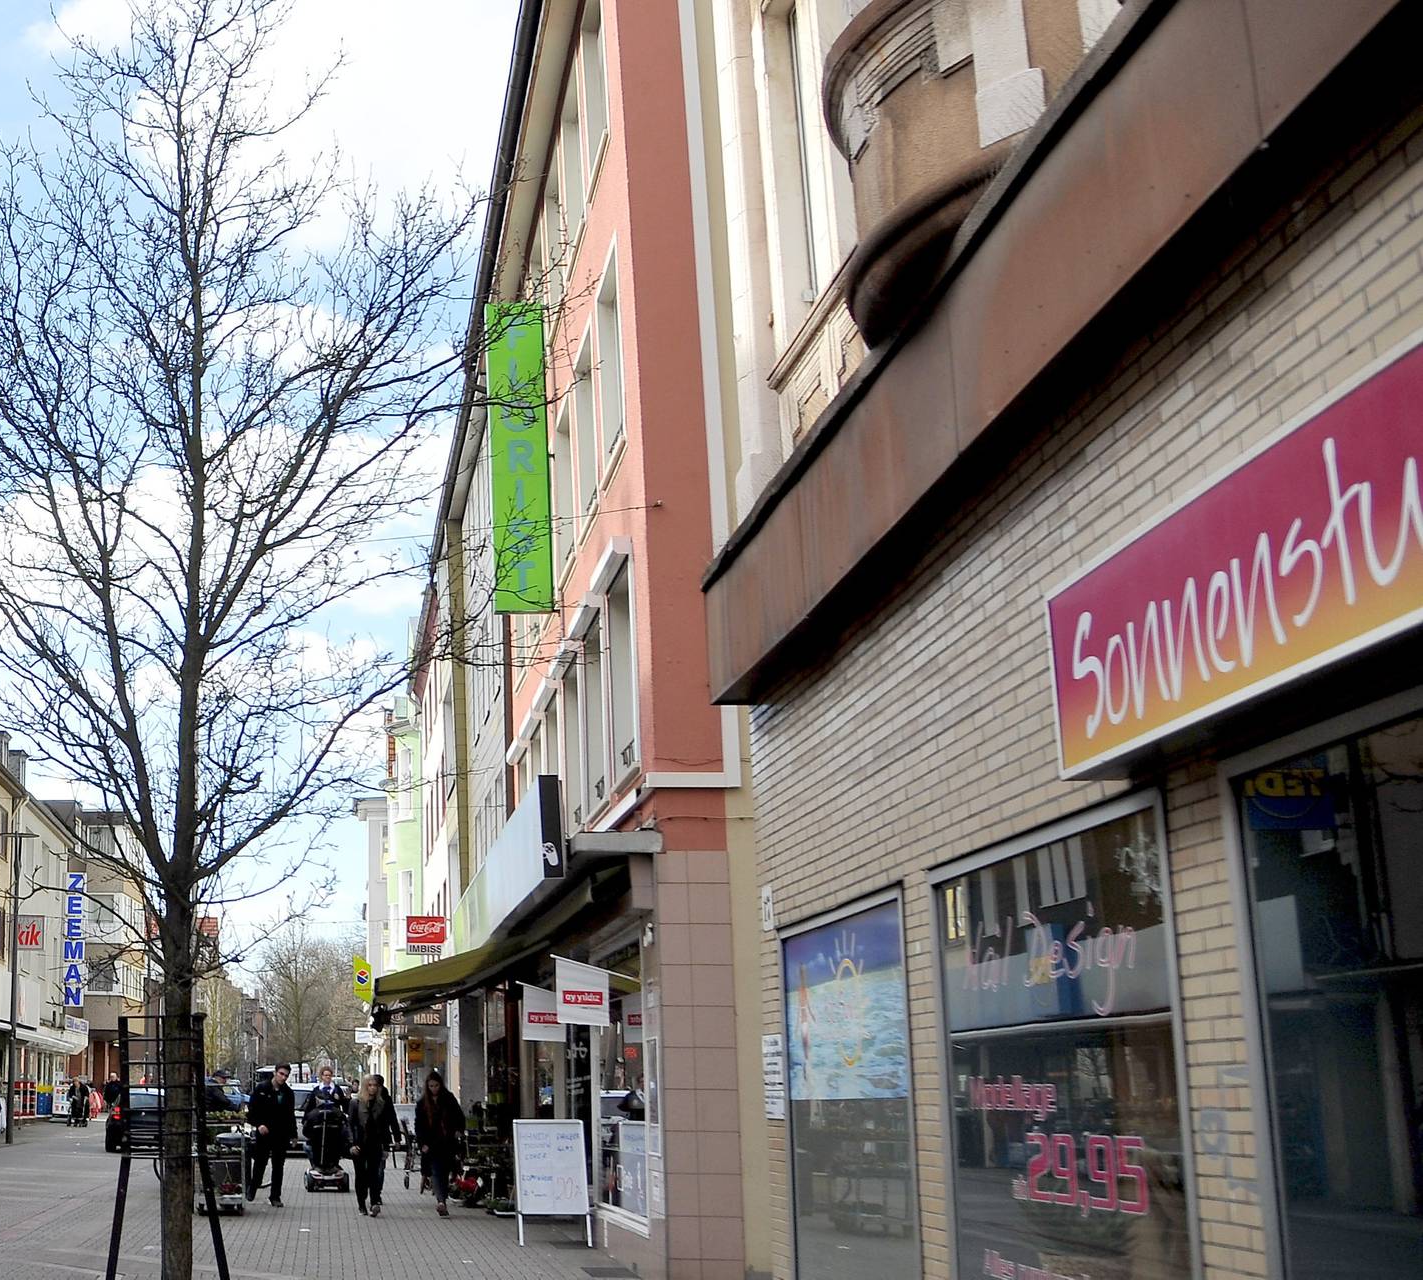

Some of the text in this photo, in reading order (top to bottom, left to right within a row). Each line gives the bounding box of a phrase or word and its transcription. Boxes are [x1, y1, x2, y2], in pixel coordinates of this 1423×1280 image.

[506, 316, 537, 593] FLORIST
[64, 873, 84, 1006] ZEEMAN
[409, 921, 444, 934] Coca-Cola
[409, 944, 442, 953] IMBISS
[413, 1013, 440, 1025] HAUS
[968, 1074, 1058, 1122] Modellage
[1025, 1132, 1149, 1218] 29,95
